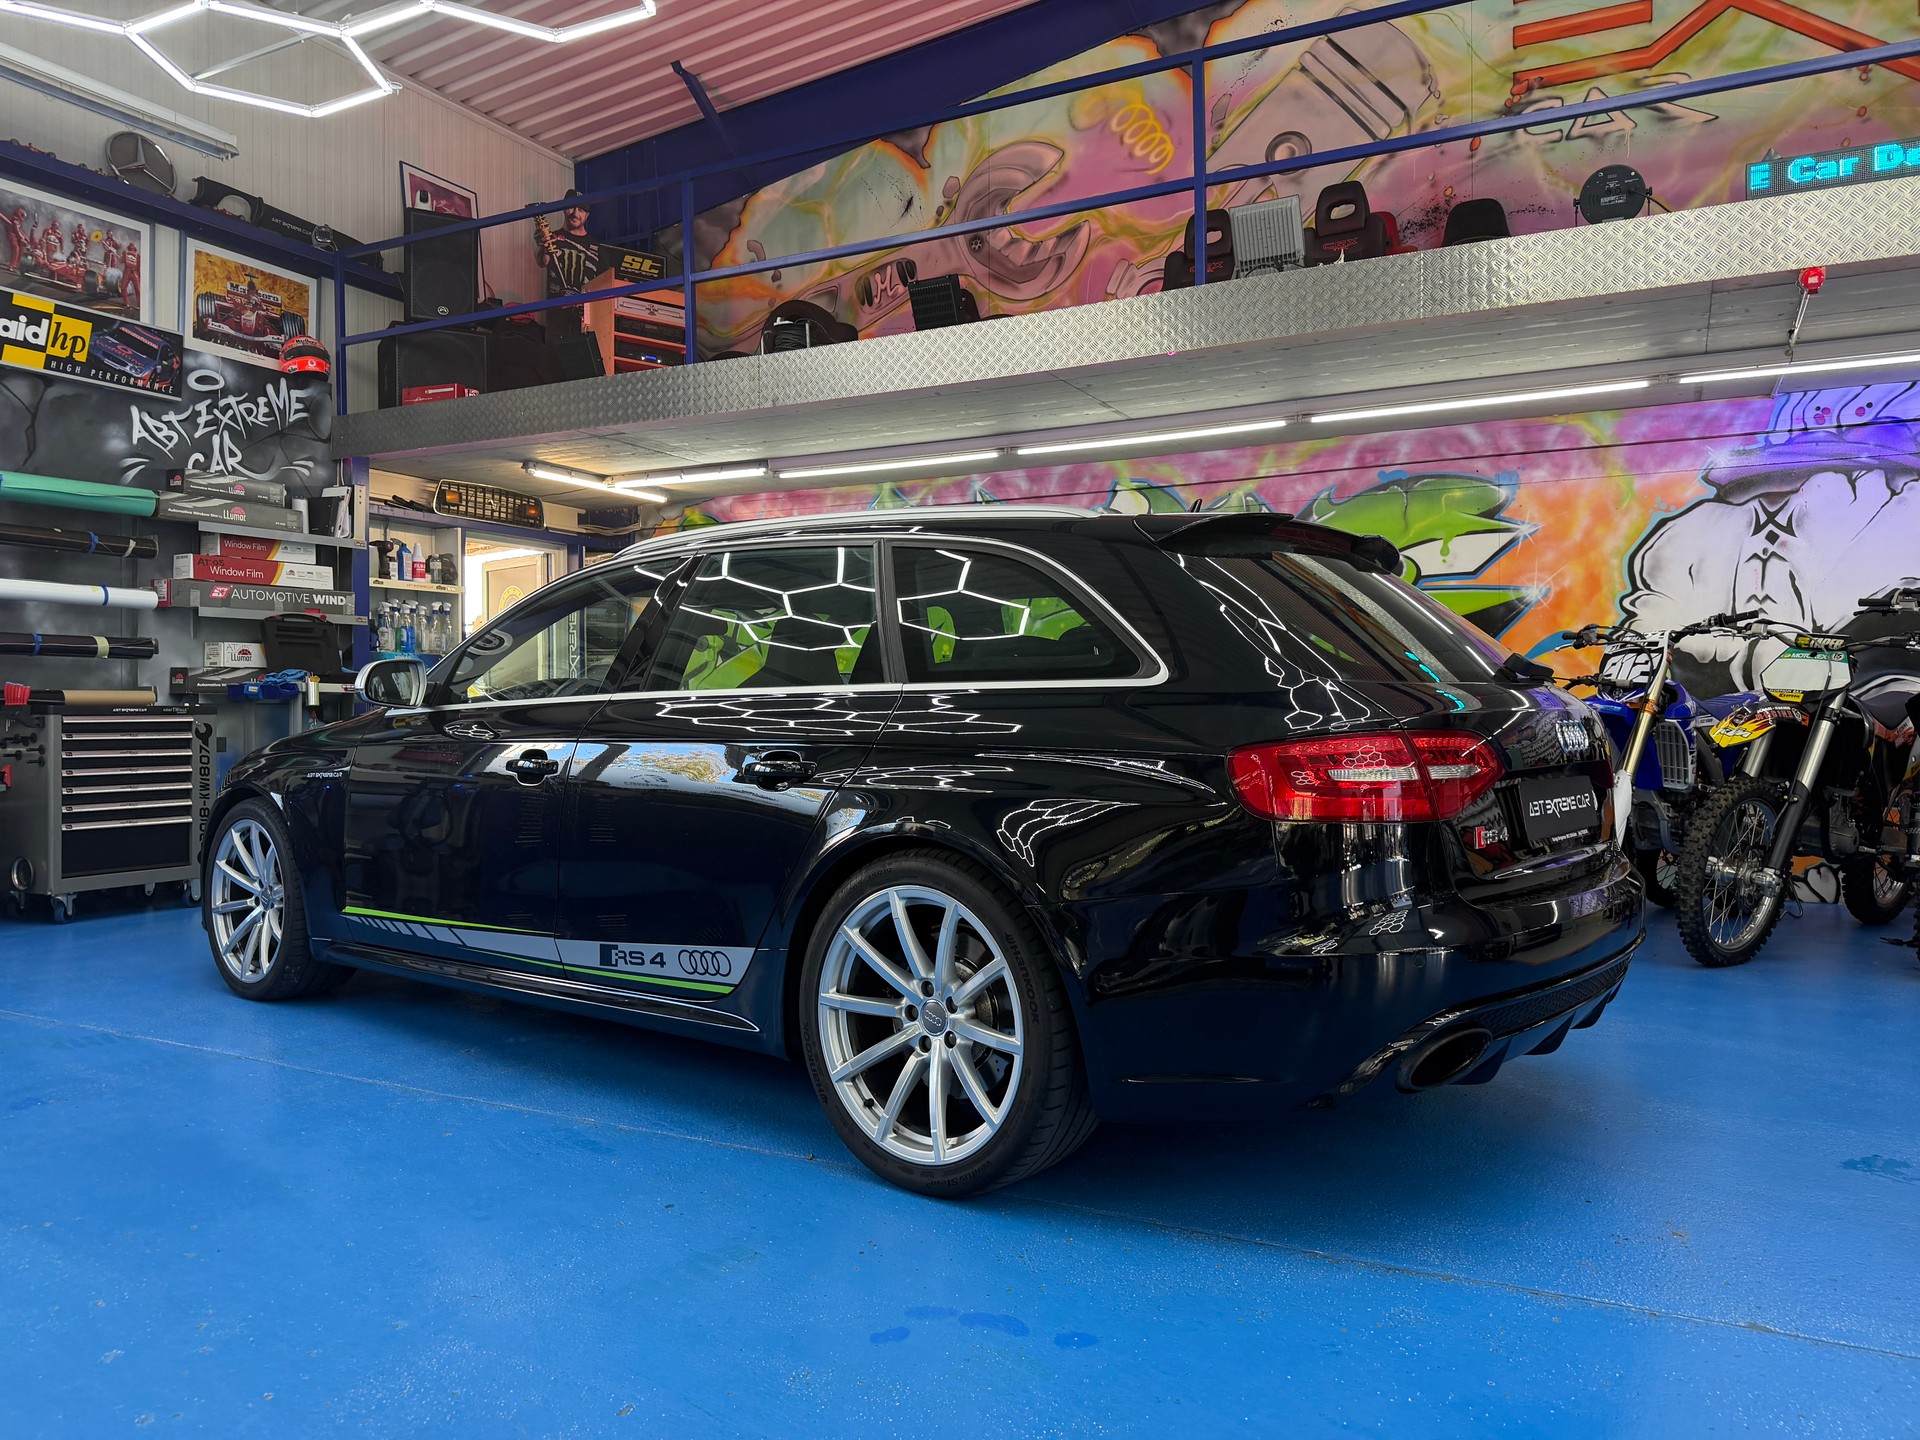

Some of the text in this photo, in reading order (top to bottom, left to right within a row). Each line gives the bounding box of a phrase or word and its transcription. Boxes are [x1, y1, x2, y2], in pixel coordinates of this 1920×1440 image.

[1788, 157, 1860, 184] Car
[0, 314, 49, 347] aid
[50, 322, 87, 361] hp
[51, 361, 174, 394] HIGH PERFORMANCE
[130, 377, 312, 460] ABT EXTREME
[187, 430, 255, 480] CAR
[167, 507, 192, 515] Automotive
[224, 539, 267, 551] Window Film
[209, 565, 264, 579] Window Film
[231, 588, 346, 606] AUTOMOTIVE WIND
[1809, 637, 1845, 650] TAPER
[1529, 793, 1591, 818] ABT EXTREME CAR
[605, 945, 667, 969] RS 4
